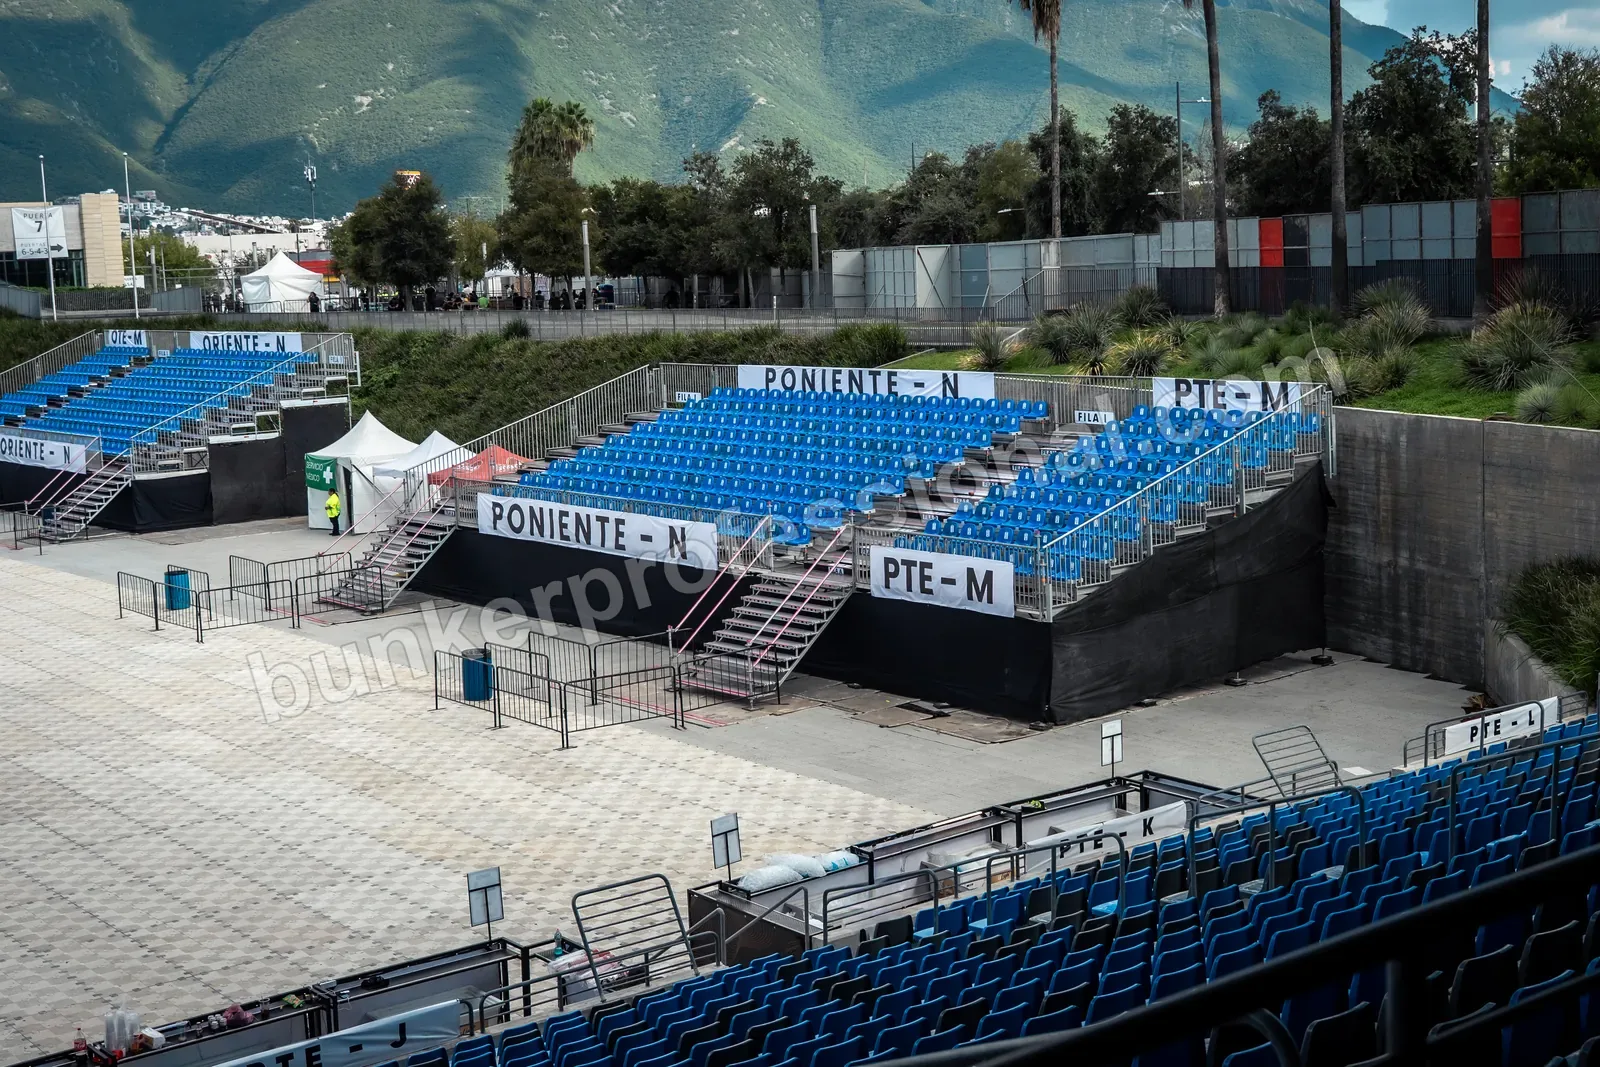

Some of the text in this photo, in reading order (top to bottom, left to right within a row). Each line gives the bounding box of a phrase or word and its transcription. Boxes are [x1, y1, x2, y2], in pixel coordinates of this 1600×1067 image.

[34, 220, 43, 233] 7
[203, 334, 259, 352] ORIENTE
[276, 335, 285, 352] N
[765, 367, 899, 397] PONIENTE
[942, 372, 958, 399] N
[1174, 378, 1227, 410] PTE
[1078, 412, 1099, 423] FILA
[0, 437, 45, 461] ORIENTE
[63, 445, 71, 464] N
[492, 501, 626, 551] PONIENTE
[668, 525, 688, 560] N
[883, 556, 935, 596] PTE
[1470, 719, 1501, 743] PTE
[1528, 710, 1535, 726] L
[1059, 829, 1104, 859] PTE
[1142, 816, 1155, 838] K
[247, 1044, 323, 1067] TE
[390, 1022, 408, 1049] J
